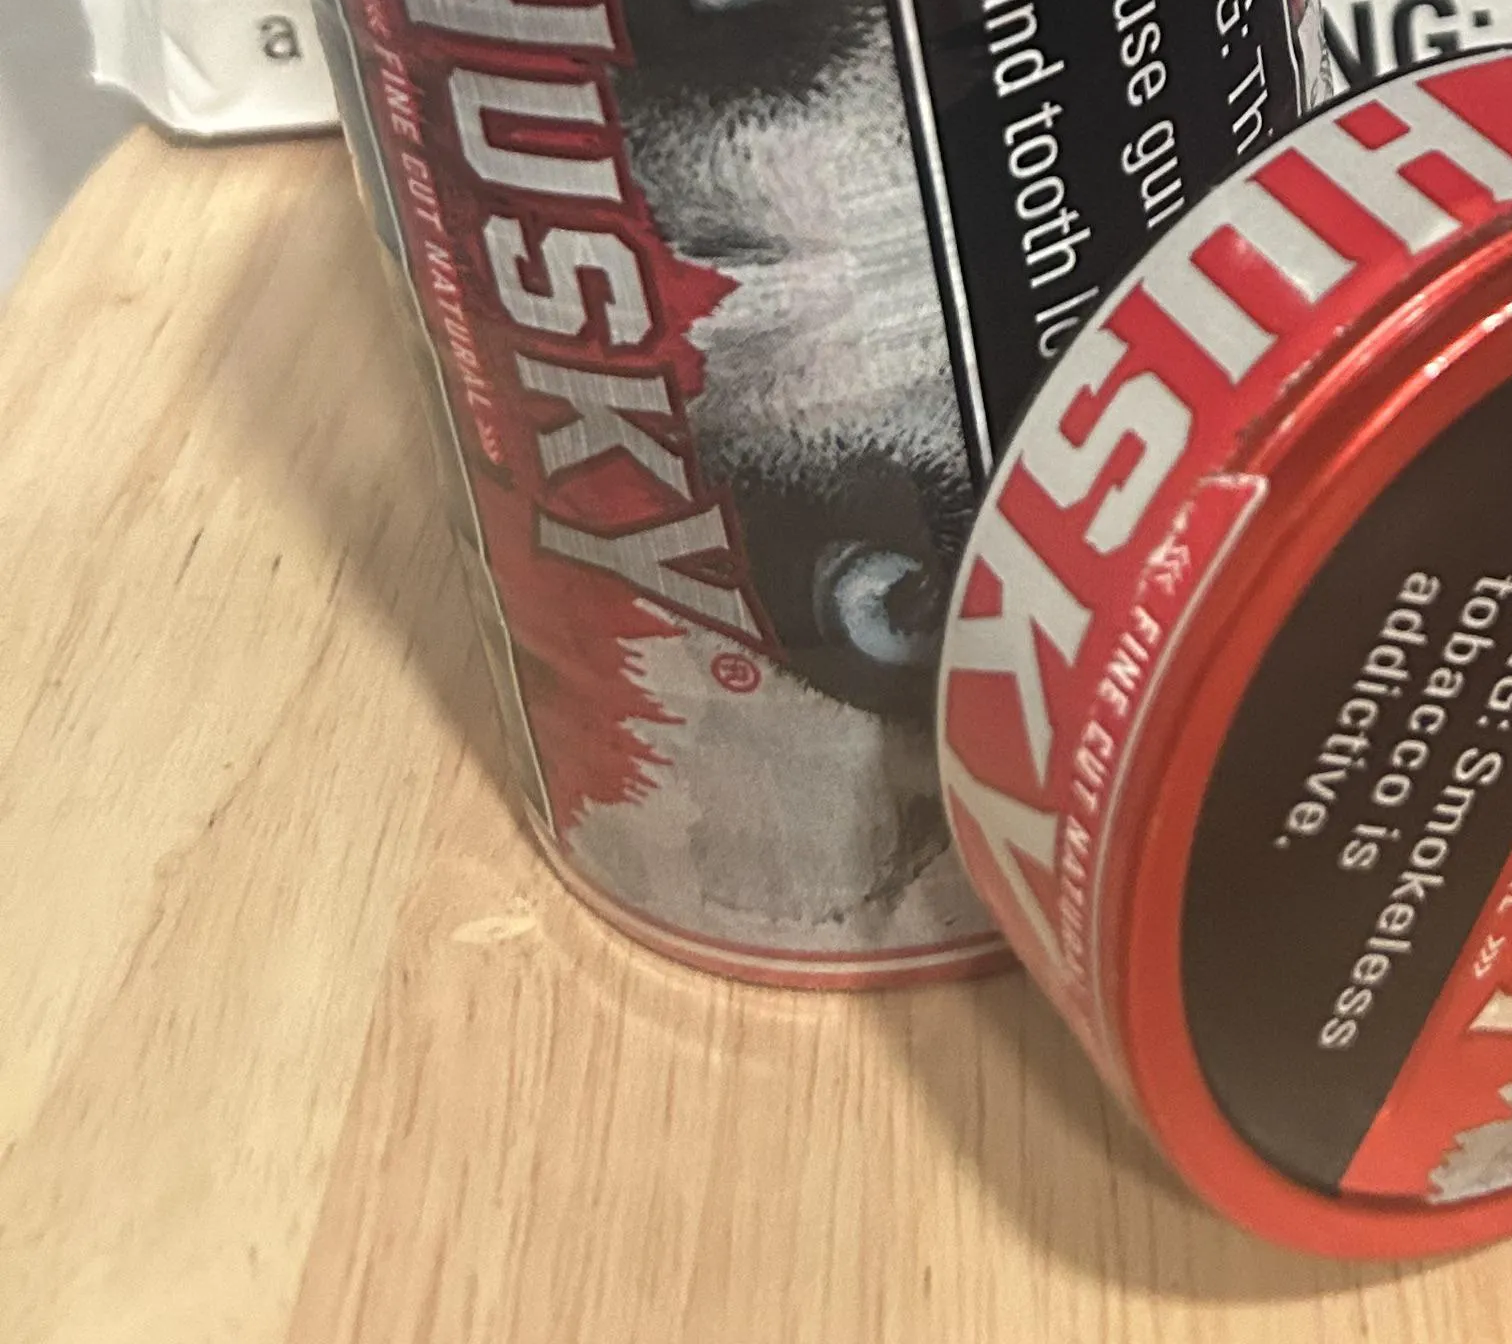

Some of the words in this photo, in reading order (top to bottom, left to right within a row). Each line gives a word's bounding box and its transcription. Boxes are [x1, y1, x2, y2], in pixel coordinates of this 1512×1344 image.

[1226, 45, 1274, 156] Th
[374, 42, 423, 147] FINE
[402, 149, 442, 232] CUT
[423, 236, 492, 409] NATURAL
[1003, 100, 1093, 290] tooth
[1120, 119, 1186, 230] gu
[1097, 602, 1164, 718] FINE
[1274, 570, 1441, 851] addictive.
[1070, 720, 1118, 814] CUT
[1317, 747, 1502, 1052] Smokeless
[1337, 817, 1402, 873] is
